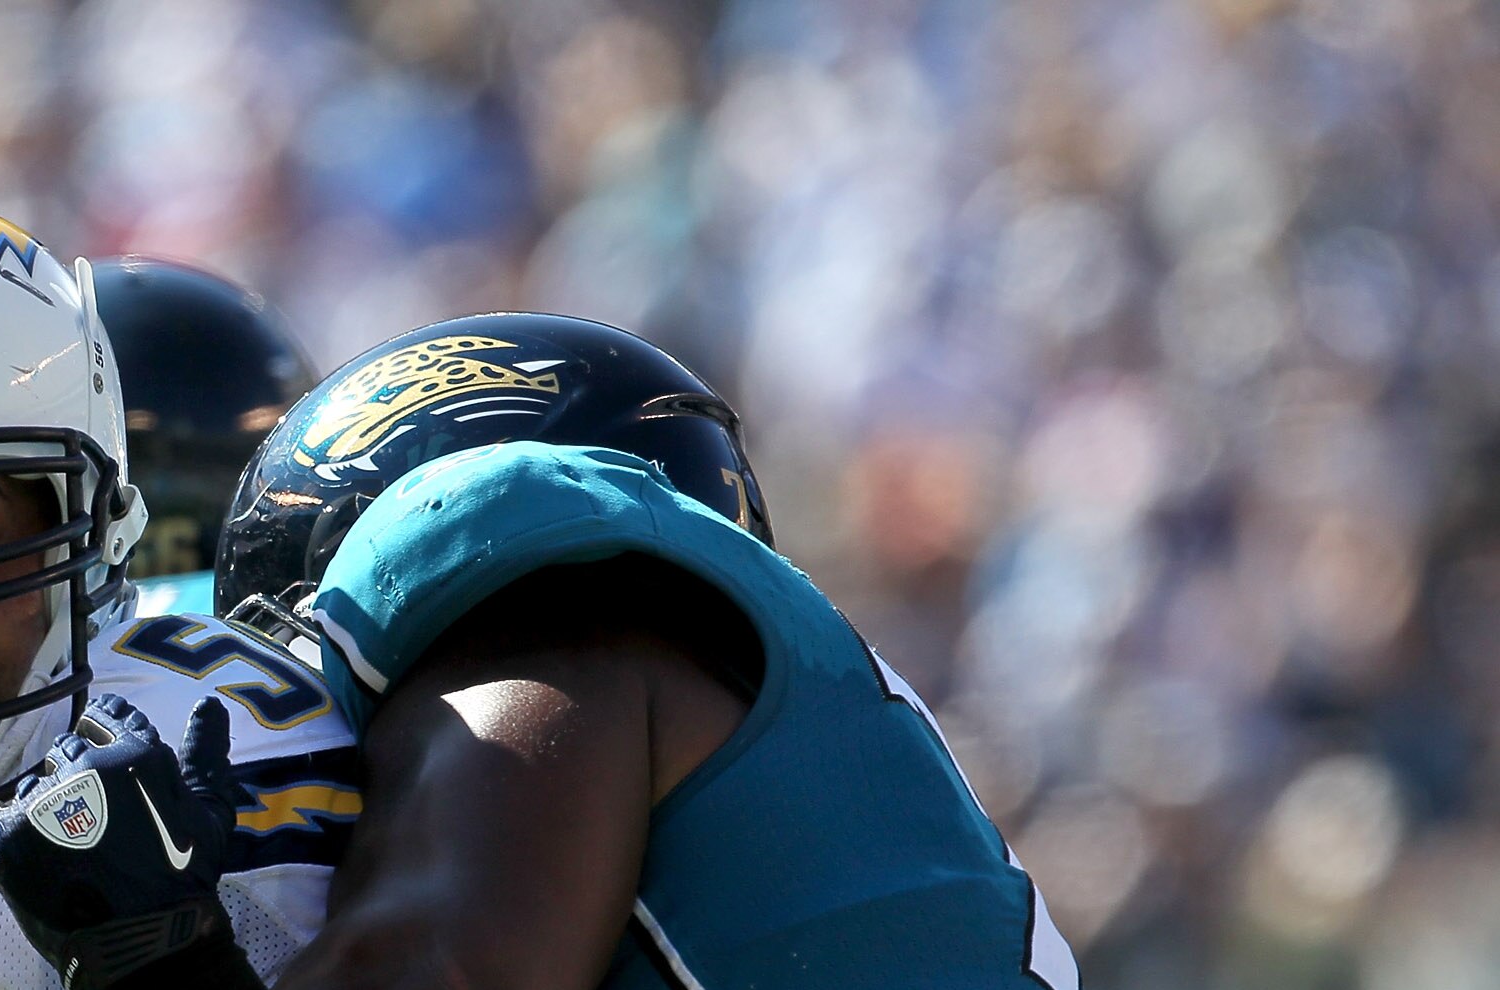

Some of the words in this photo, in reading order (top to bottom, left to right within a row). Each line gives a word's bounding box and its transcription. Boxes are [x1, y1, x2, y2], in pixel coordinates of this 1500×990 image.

[93, 341, 104, 368] 56
[37, 780, 91, 817] EQUIPMENT
[63, 811, 94, 836] NFL
